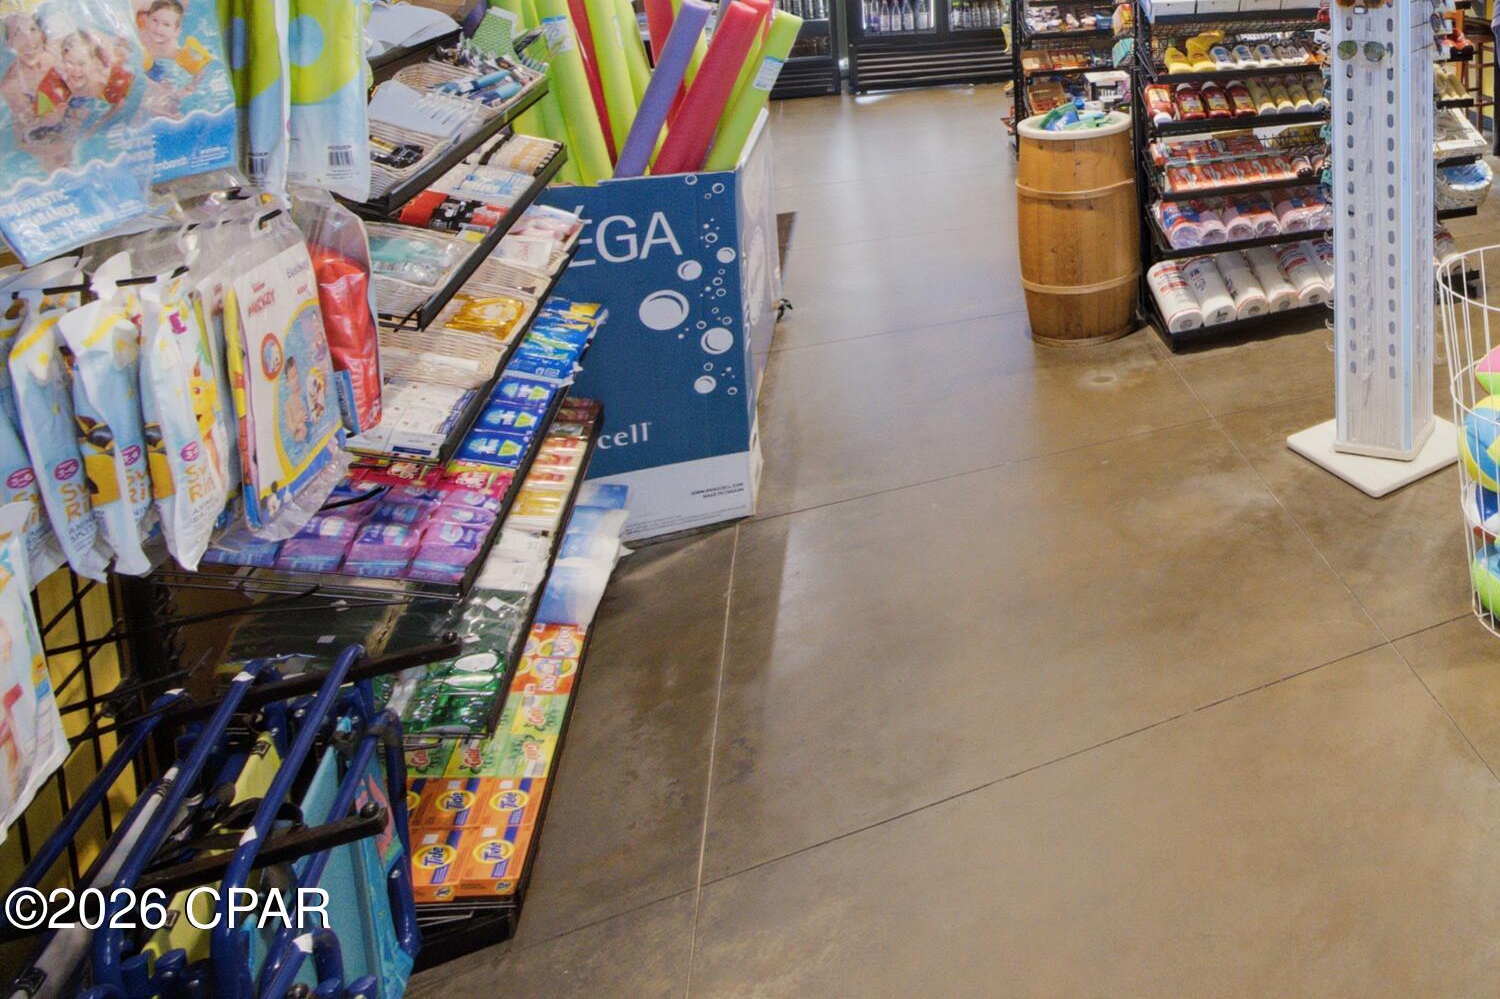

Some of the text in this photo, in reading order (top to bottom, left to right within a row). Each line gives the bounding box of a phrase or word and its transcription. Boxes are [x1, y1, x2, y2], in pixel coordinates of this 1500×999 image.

[597, 422, 650, 450] cell
[446, 791, 465, 810] Tide
[499, 791, 518, 809] Tide
[424, 846, 444, 866] Tide
[483, 842, 503, 860] Tide
